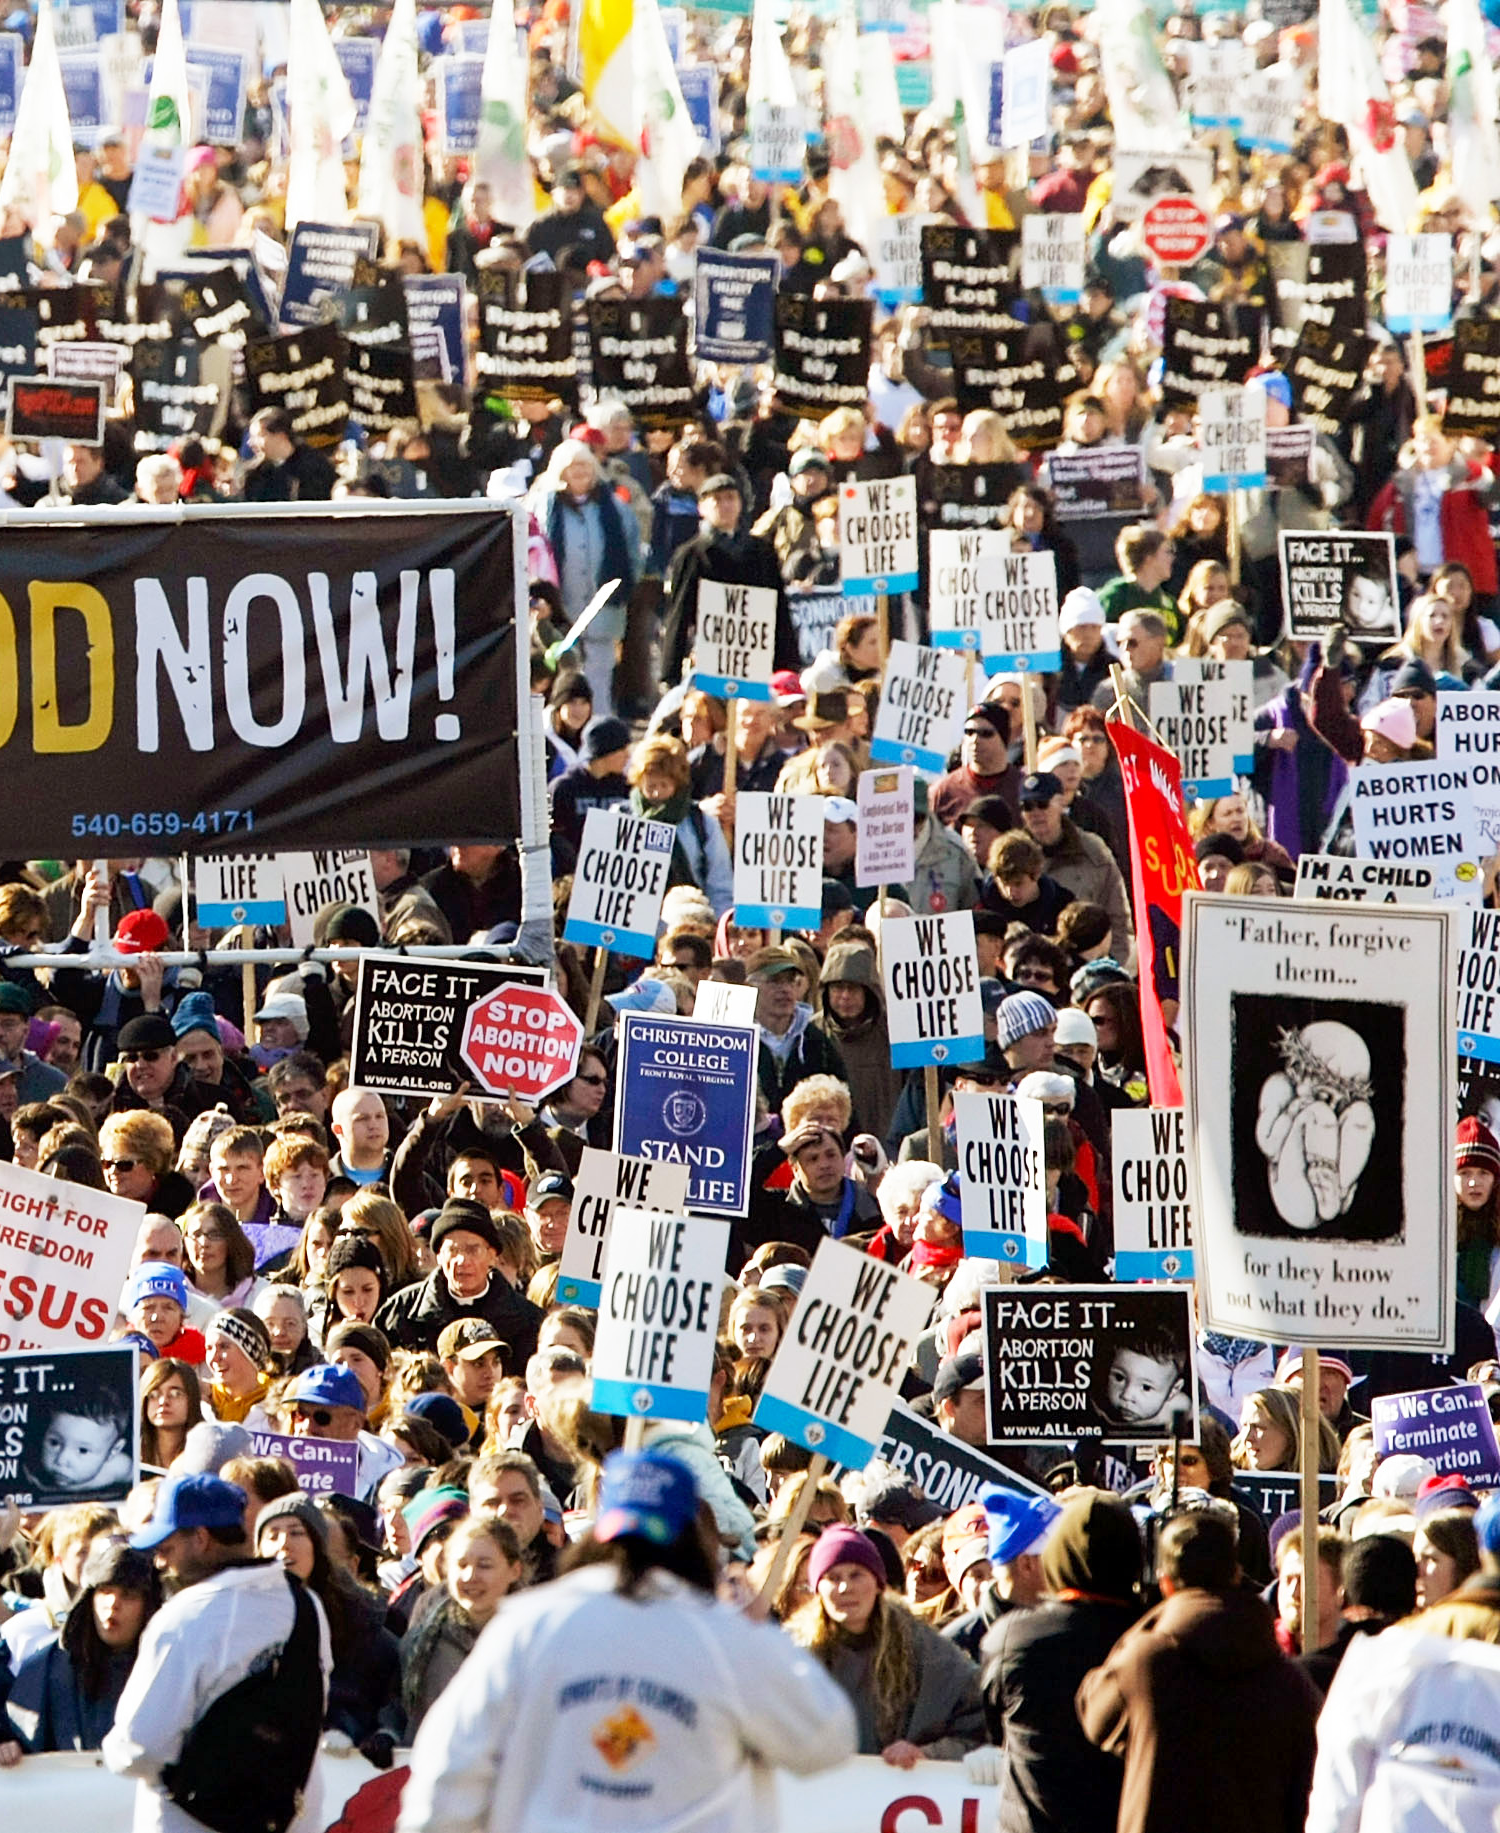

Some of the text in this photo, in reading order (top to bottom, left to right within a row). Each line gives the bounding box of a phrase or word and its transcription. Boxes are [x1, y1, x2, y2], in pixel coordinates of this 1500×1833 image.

[1152, 206, 1199, 223] STOP
[1155, 237, 1196, 254] NOW
[600, 336, 677, 357] Regret
[869, 484, 891, 513] WE
[847, 515, 912, 544] CHOOSE
[864, 545, 896, 573] LIFE
[1288, 542, 1330, 563] FACE
[1005, 556, 1030, 586] WE
[1291, 566, 1343, 583] ABORTION
[985, 587, 1051, 619] CHOOSE
[1292, 584, 1343, 603] KILLS
[1305, 603, 1341, 619] PERSON
[1004, 621, 1037, 650] LIFE
[135, 568, 461, 754] NOW!
[1356, 771, 1468, 798] ABORTION
[71, 810, 256, 837] 540-659-4171
[768, 797, 794, 830] WE
[1373, 802, 1455, 827] HURTS
[616, 819, 644, 851] WE
[1369, 833, 1463, 859] WOMEN
[742, 833, 817, 868] CHOOSE
[583, 850, 664, 895] CHOOSE
[760, 869, 798, 904] LIFE
[1301, 858, 1431, 888] I'M A CHILD
[594, 889, 634, 928] LIFE
[915, 918, 945, 957] WE
[1330, 924, 1412, 957] forgive
[371, 970, 481, 1000] FACE IT.
[892, 954, 974, 999] CHOOSE
[1276, 958, 1357, 985] them...
[369, 1001, 454, 1023] ABORTION
[487, 1002, 566, 1032] STOP
[917, 999, 959, 1038] LIFE
[368, 1019, 450, 1050] KILLS
[470, 1024, 575, 1060] ABORTION
[631, 1026, 747, 1051] CHRISTENDOM
[365, 1047, 442, 1068] A PERSON
[483, 1053, 554, 1083] NOW
[654, 1050, 729, 1071] COLLEGE
[640, 1068, 666, 1078] FRONT
[698, 1074, 734, 1085] VIRGINIA
[988, 1097, 1020, 1140] WE
[640, 1140, 725, 1168] STAND
[965, 1140, 1039, 1189] CHOOSE
[686, 1178, 734, 1202] LIFE
[64, 1208, 109, 1239] FOR
[990, 1189, 1026, 1233] LIFE
[648, 1221, 684, 1272] WE
[1244, 1252, 1393, 1288] for they know
[610, 1270, 710, 1332] CHOOSE
[851, 1262, 899, 1319] WE
[997, 1302, 1135, 1329] FACE IT...
[1227, 1291, 1254, 1311] not
[1259, 1296, 1307, 1319] what
[1314, 1297, 1364, 1330] they
[624, 1328, 677, 1383] LIFE
[797, 1299, 907, 1386] CHOOSE
[999, 1338, 1093, 1359] ABORTION
[13, 1365, 75, 1394] IT...
[1000, 1361, 1091, 1391] KILLS
[802, 1360, 864, 1426] LIFE
[1002, 1392, 1087, 1411] A PERSON
[1399, 1396, 1429, 1418] We
[1431, 1393, 1485, 1413] Can...
[1384, 1421, 1478, 1451] Terminate
[288, 1440, 352, 1464] Can...
